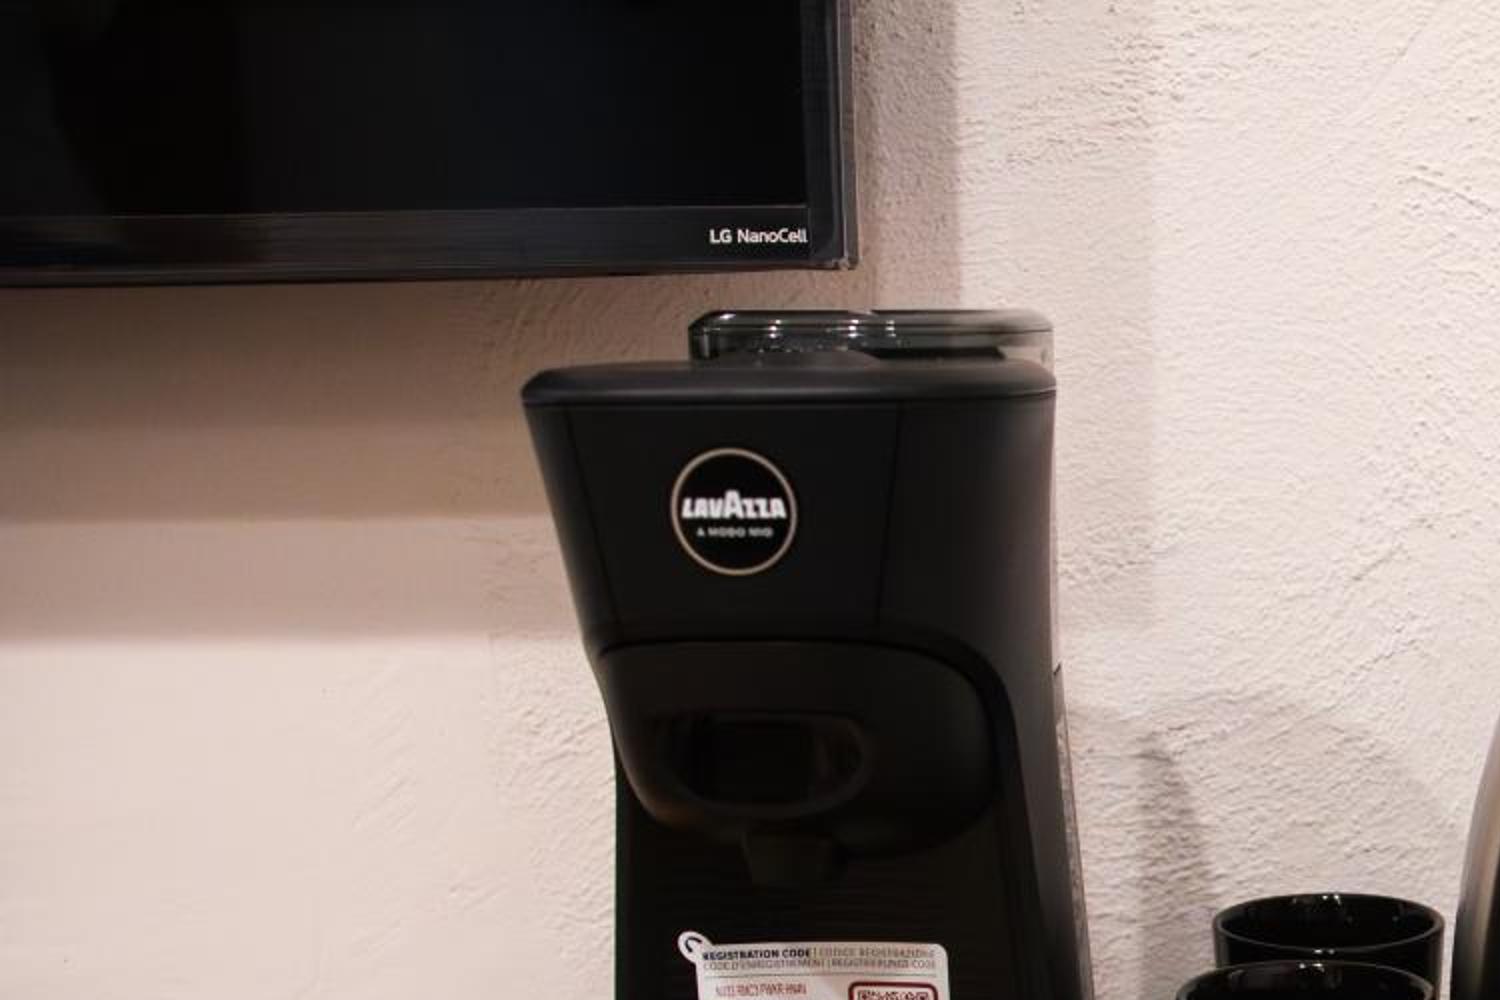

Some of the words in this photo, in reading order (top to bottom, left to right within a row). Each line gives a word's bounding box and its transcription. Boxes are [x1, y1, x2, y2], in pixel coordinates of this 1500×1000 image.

[709, 228, 733, 244] LG
[737, 227, 808, 244] NanoCell
[681, 489, 787, 519] LAVAZZA
[696, 527, 705, 537] A
[707, 527, 746, 538] MODO
[748, 527, 774, 538] MIO
[703, 949, 780, 960] REGISTRATION
[782, 947, 810, 959] CODE
